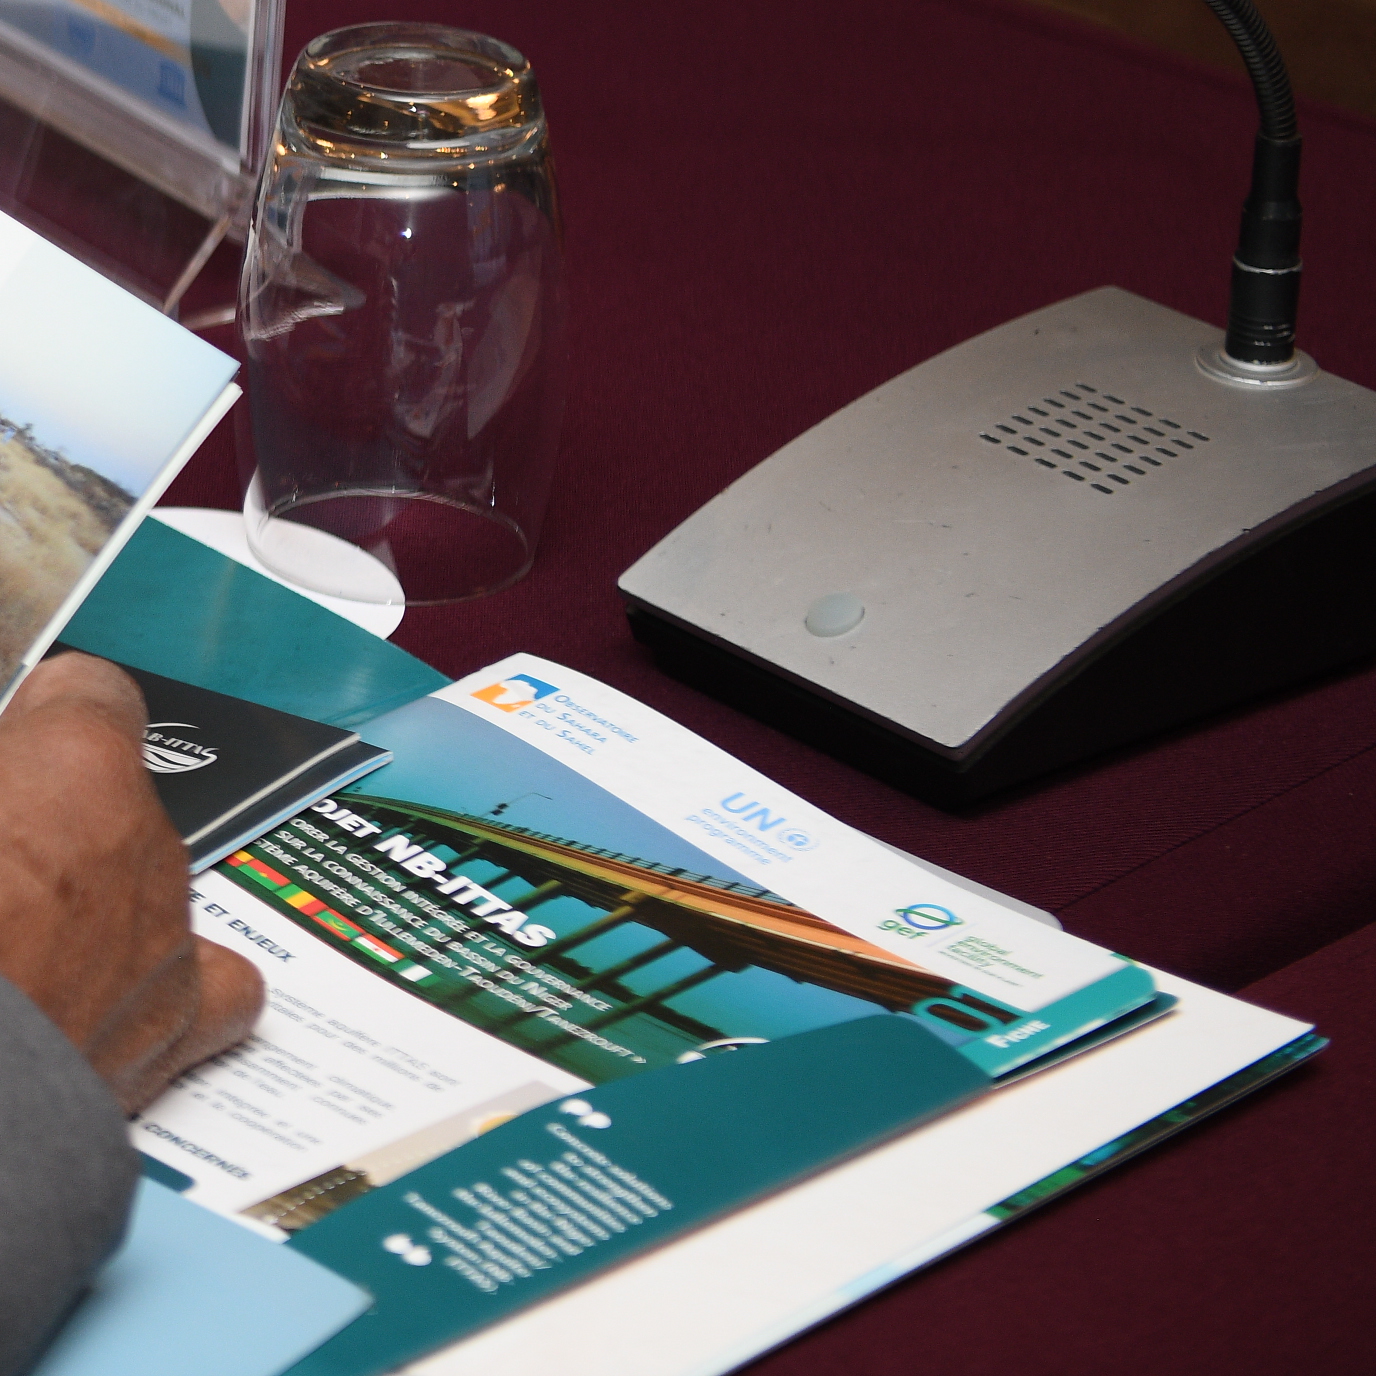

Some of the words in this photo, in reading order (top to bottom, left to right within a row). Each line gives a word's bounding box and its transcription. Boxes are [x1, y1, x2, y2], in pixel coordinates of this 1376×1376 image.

[684, 814, 773, 866] programme
[701, 806, 794, 863] environment
[721, 791, 788, 832] UN
[253, 837, 300, 867] STÈME
[292, 863, 362, 909] AQUIFÈRE
[310, 798, 383, 839] OJET
[374, 832, 558, 950] NB-ITTAS
[205, 902, 231, 920] ET
[228, 918, 299, 964] ENJEUX
[273, 829, 308, 852] SUR
[301, 846, 326, 863] LA
[322, 859, 430, 930] CONNAISSANCE
[422, 926, 454, 945] DU
[445, 940, 504, 975] BASSIN
[496, 967, 526, 987] DU
[288, 817, 331, 844] ORER
[324, 839, 349, 856] LA
[345, 852, 408, 894] GESTION
[463, 931, 492, 948] ET
[482, 940, 508, 959] LA
[504, 953, 615, 1013] GOUVERNANCE
[875, 918, 931, 941] gef
